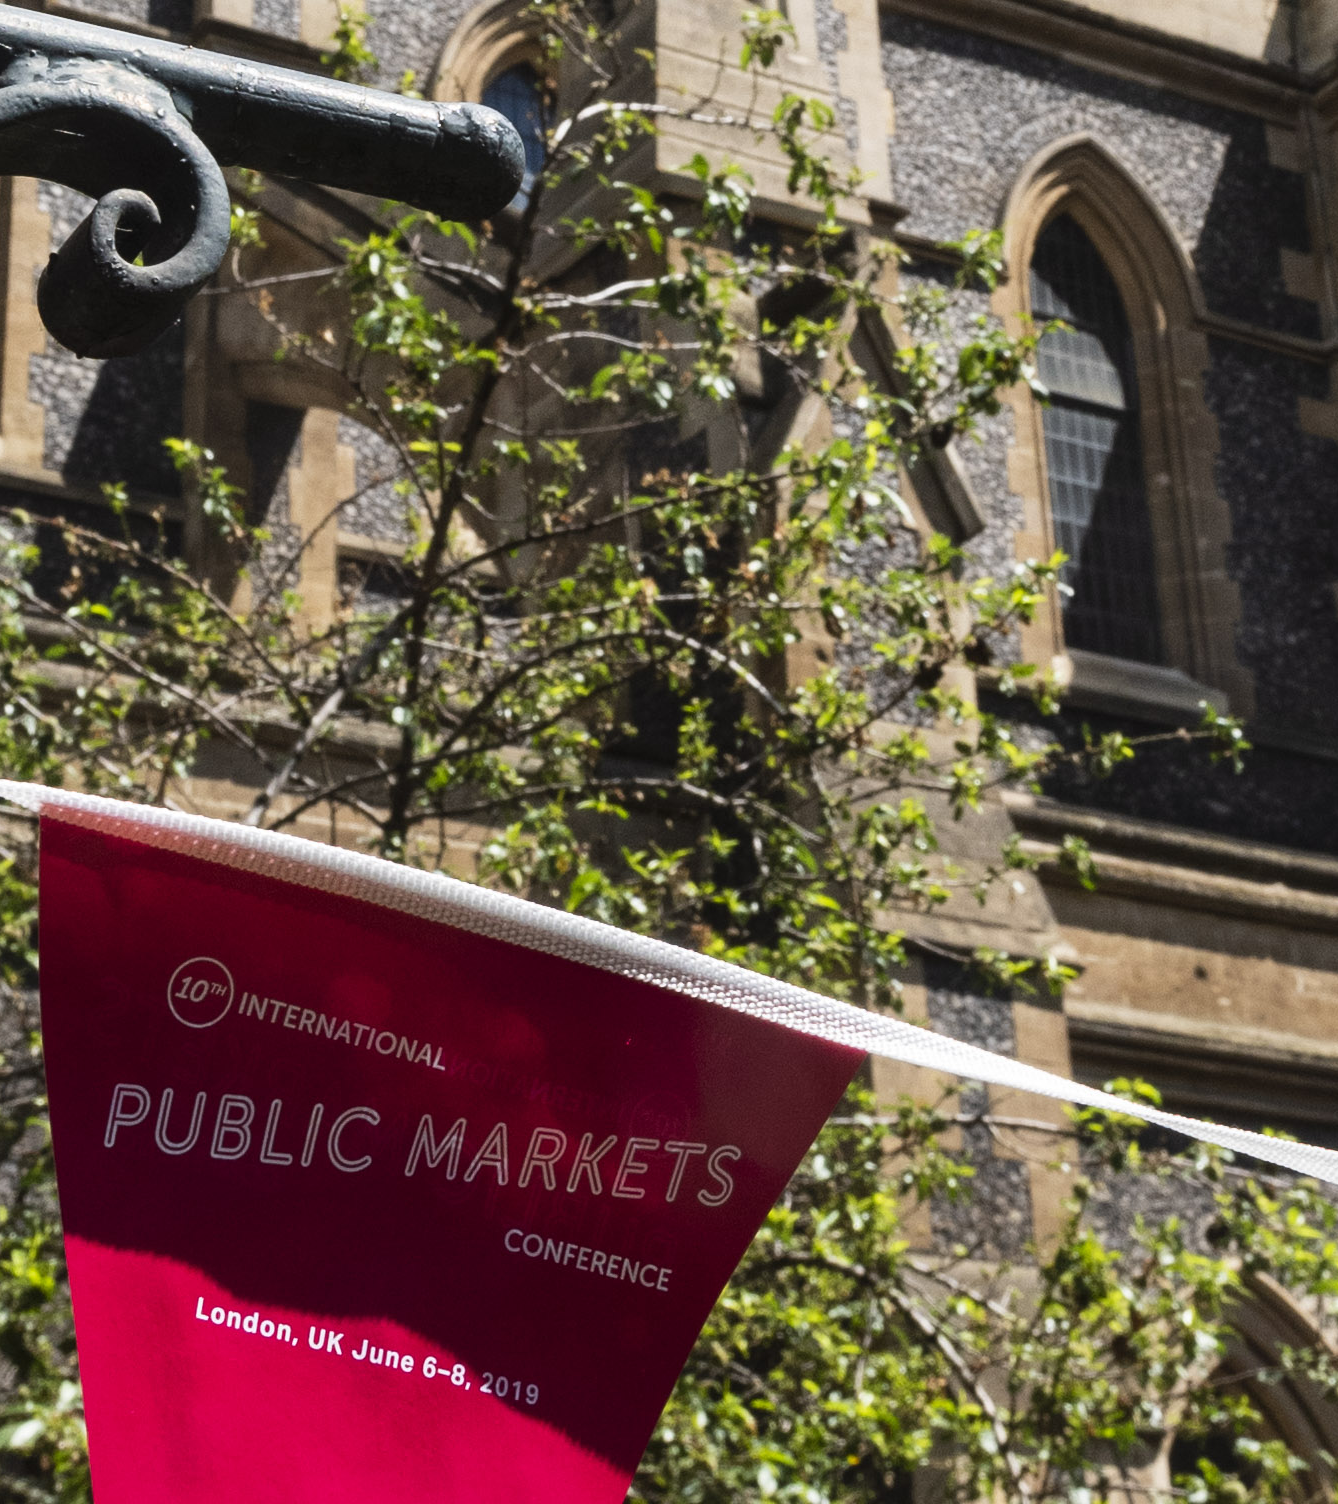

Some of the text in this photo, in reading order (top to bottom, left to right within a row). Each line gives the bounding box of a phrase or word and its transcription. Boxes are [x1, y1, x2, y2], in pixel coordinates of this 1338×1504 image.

[237, 991, 447, 1072] INTERNATIONAL
[103, 1083, 742, 1207] PUBLIC MARKETS
[504, 1228, 673, 1292] CONFERENCE
[195, 1296, 299, 1347] London,
[308, 1325, 345, 1356] UK
[351, 1339, 415, 1373] June
[479, 1372, 539, 1405] 2019
